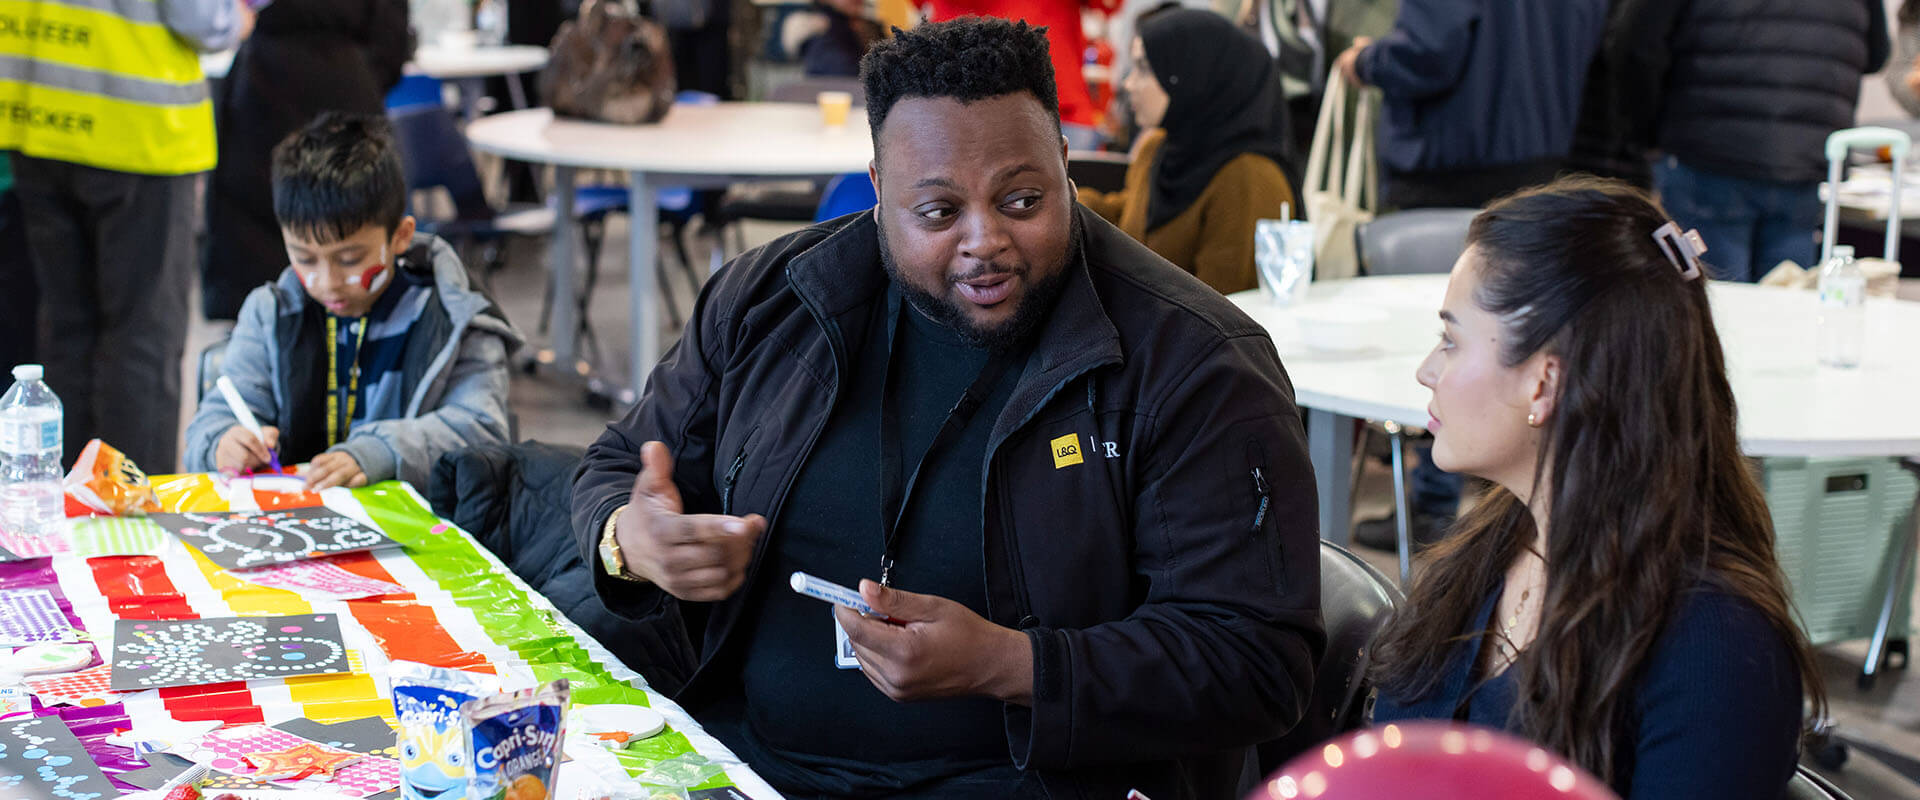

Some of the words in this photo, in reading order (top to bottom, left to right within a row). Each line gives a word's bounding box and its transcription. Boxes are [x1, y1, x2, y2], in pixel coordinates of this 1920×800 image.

[1056, 445, 1078, 457] L&Q
[1102, 441, 1120, 458] R
[400, 706, 462, 728] Capri-S
